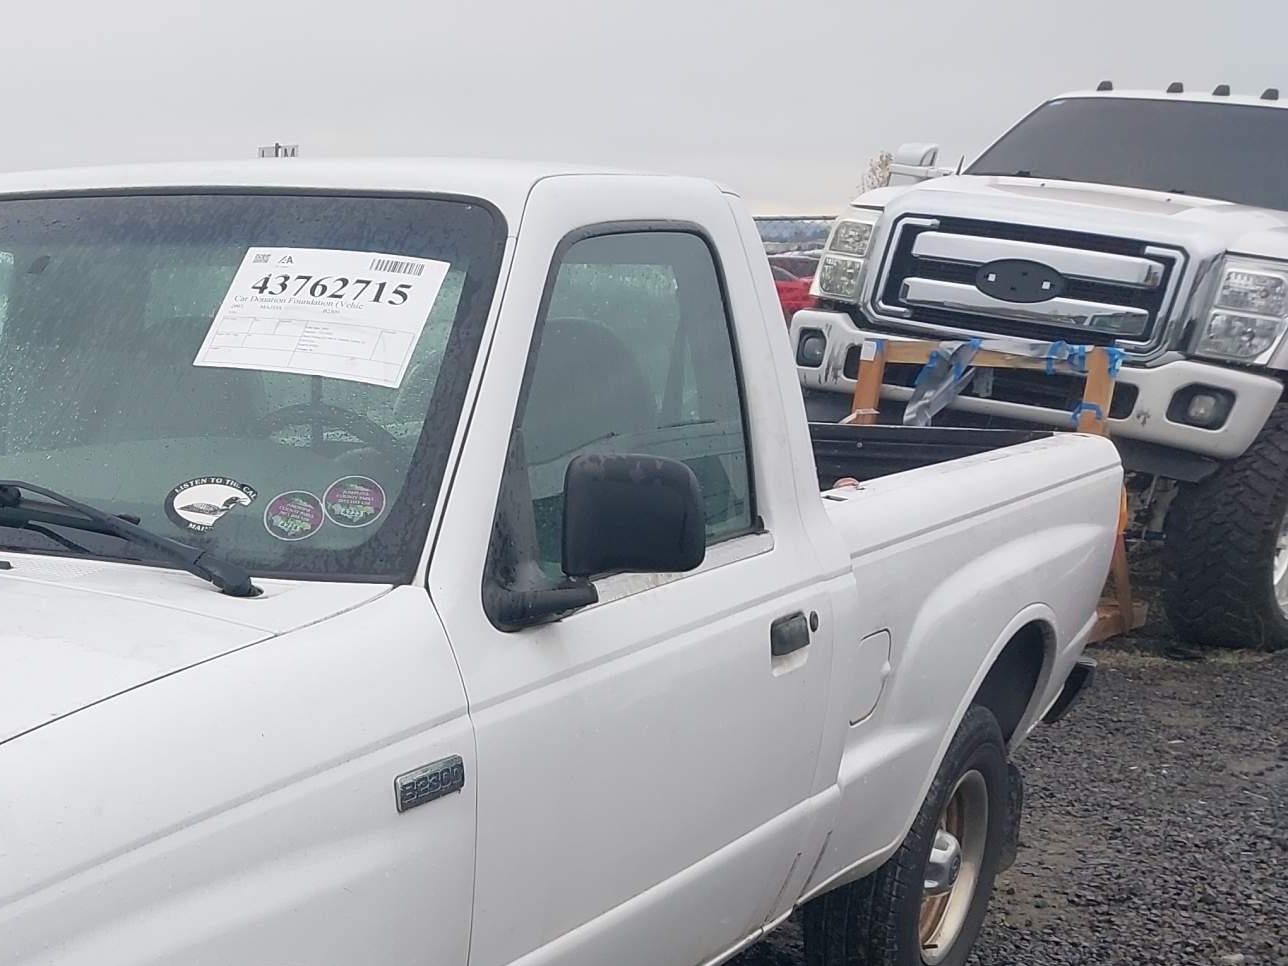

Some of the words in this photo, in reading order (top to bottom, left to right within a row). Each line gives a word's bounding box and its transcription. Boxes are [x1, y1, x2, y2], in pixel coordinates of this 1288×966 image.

[251, 273, 413, 306] 43762715
[234, 295, 248, 303] Car
[288, 297, 334, 308] Foundation
[174, 477, 208, 494] LISTEN
